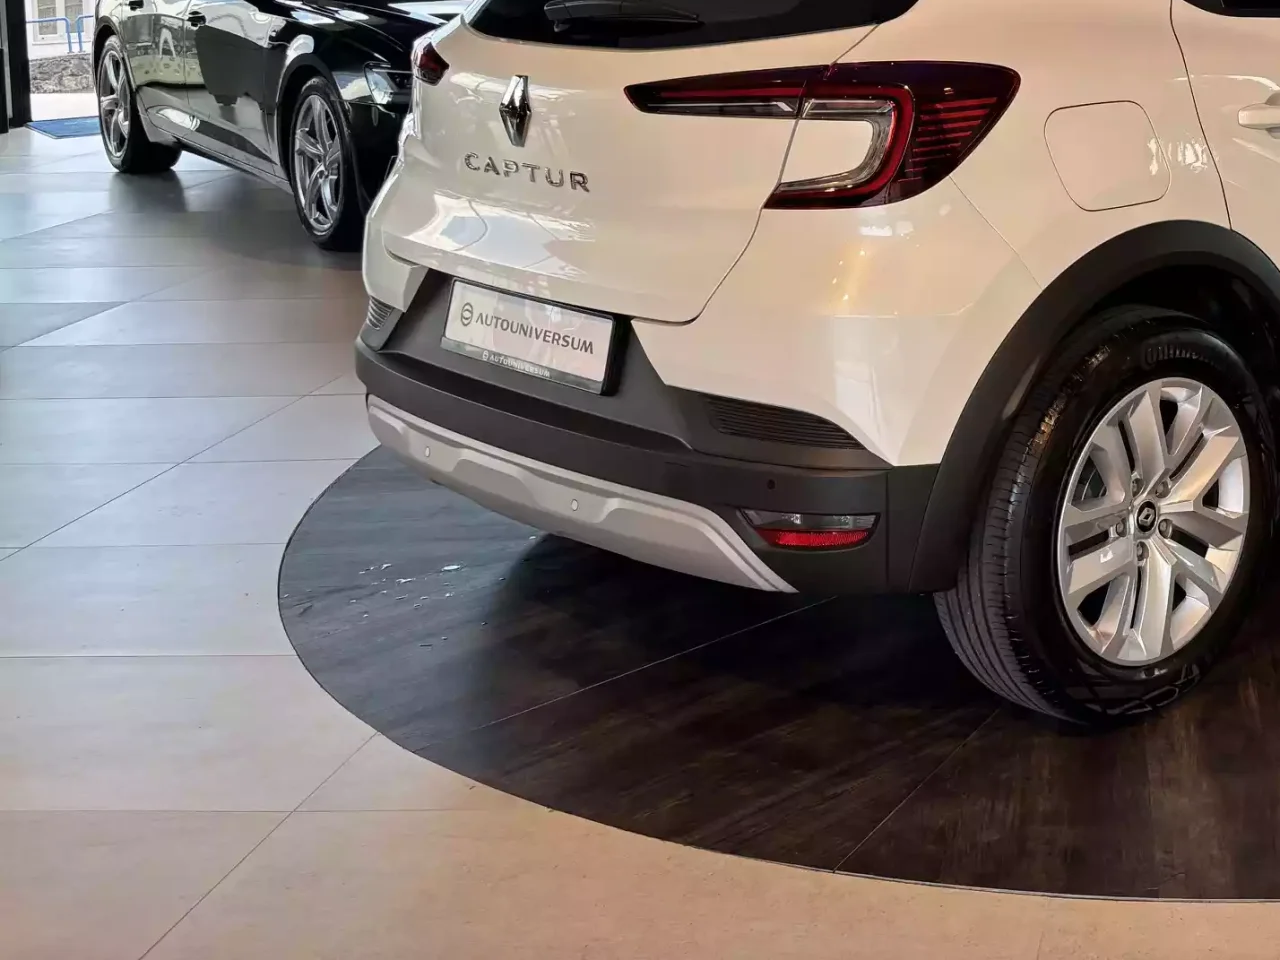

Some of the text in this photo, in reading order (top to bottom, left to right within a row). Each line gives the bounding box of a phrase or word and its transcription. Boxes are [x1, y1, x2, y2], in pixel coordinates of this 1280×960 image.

[464, 152, 590, 192] CAPTUR
[475, 313, 594, 354] AUTOUNIVERSUM
[489, 354, 551, 378] AUTOUNIVERSUM
